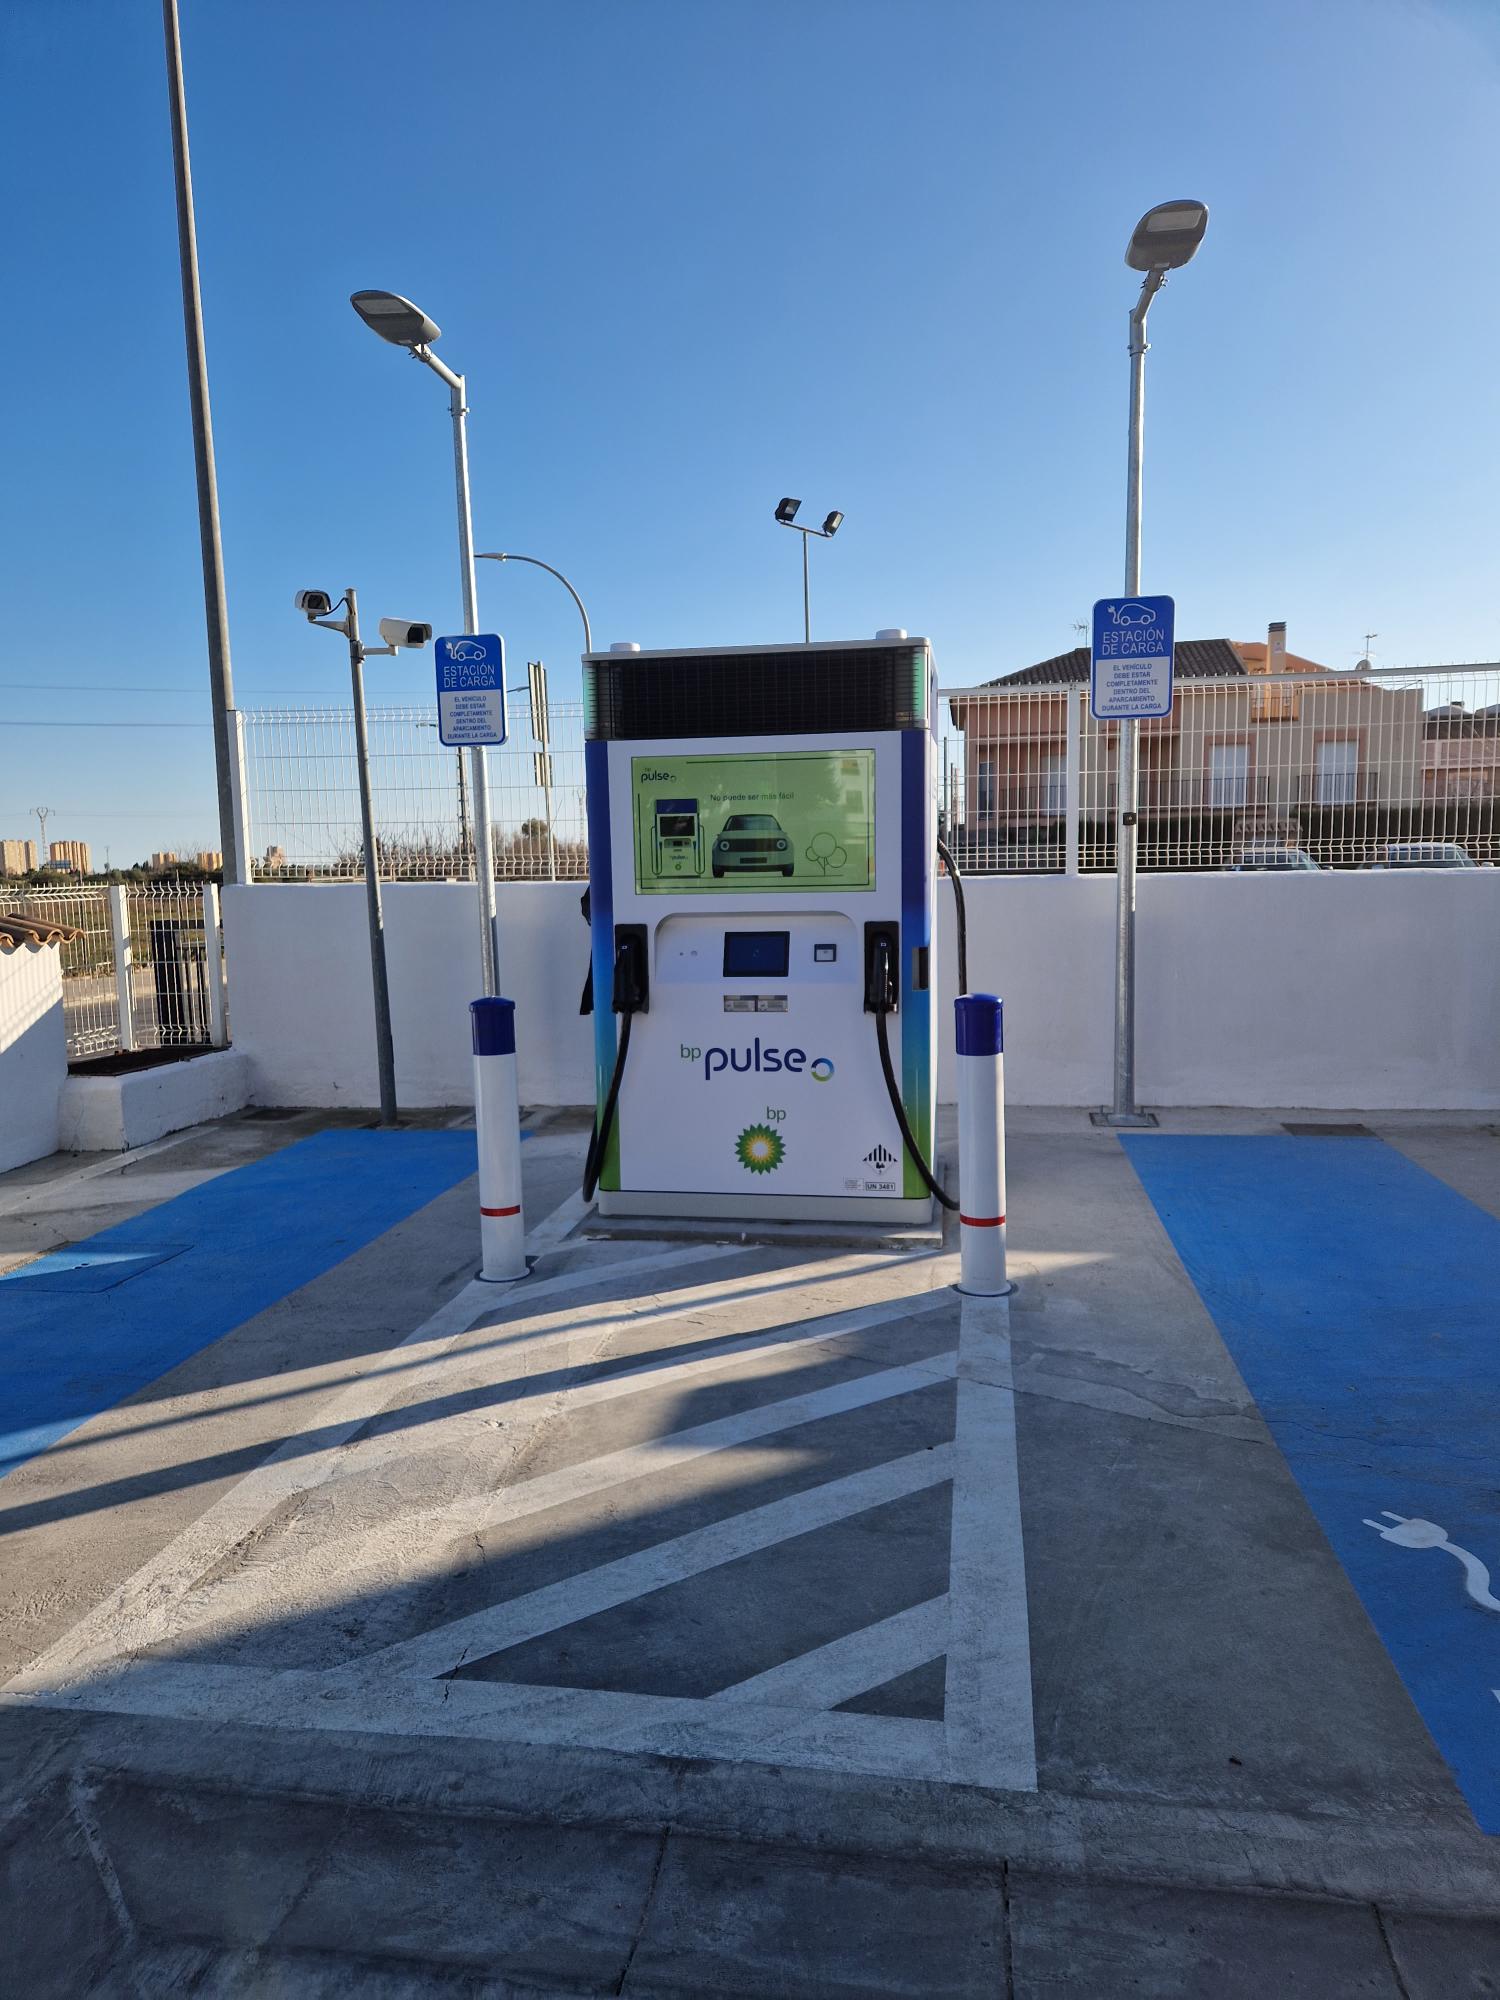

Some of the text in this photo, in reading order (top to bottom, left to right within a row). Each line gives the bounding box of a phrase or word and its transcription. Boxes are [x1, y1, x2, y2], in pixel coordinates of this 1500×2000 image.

[1103, 627, 1165, 644] ESTACIÓN
[1102, 641, 1164, 656] DE CARGA
[443, 662, 495, 677] ESTACIÓN
[443, 675, 496, 688] DE CARGA
[1106, 679, 1158, 687] COMPLETAMENTE
[641, 769, 670, 784] pulse
[710, 793, 721, 801] No
[680, 1036, 807, 1081] bp pulse
[766, 1105, 787, 1124] bp
